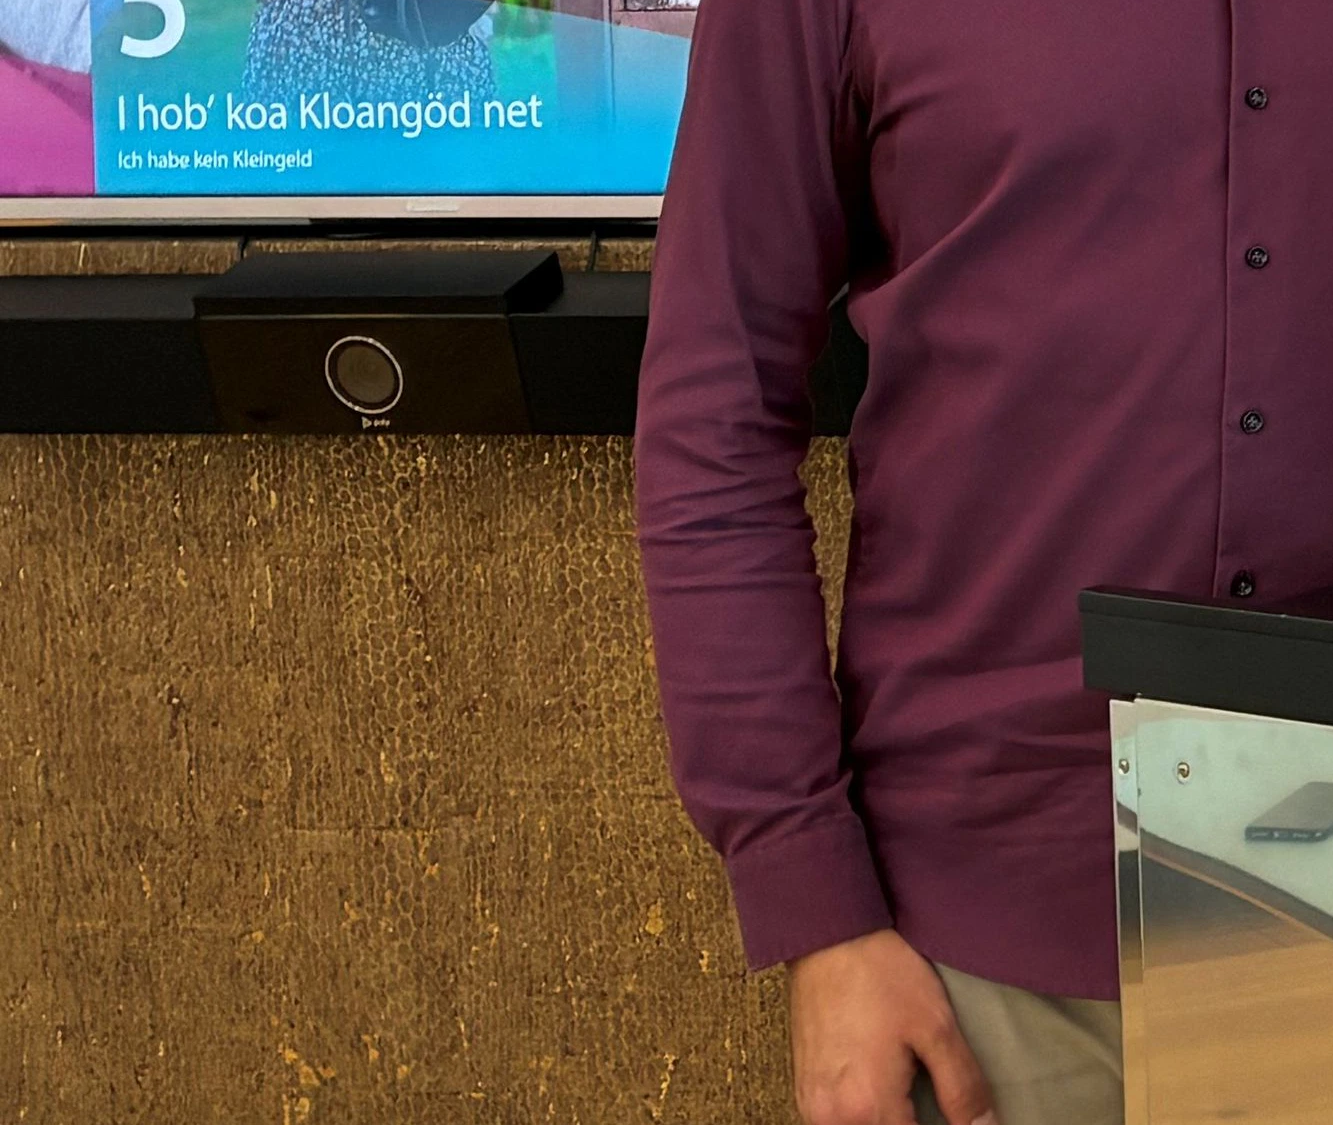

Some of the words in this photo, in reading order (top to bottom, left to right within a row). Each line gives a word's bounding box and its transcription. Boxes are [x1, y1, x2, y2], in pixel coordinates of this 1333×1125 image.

[118, 96, 126, 131] I
[138, 94, 213, 131] hob'
[227, 93, 288, 130] koa
[300, 91, 471, 139] Kloangöd
[483, 94, 543, 129] net
[118, 149, 143, 170] Ich
[147, 149, 190, 169] habe
[194, 149, 228, 170] kein
[233, 148, 313, 173] Kleingeld
